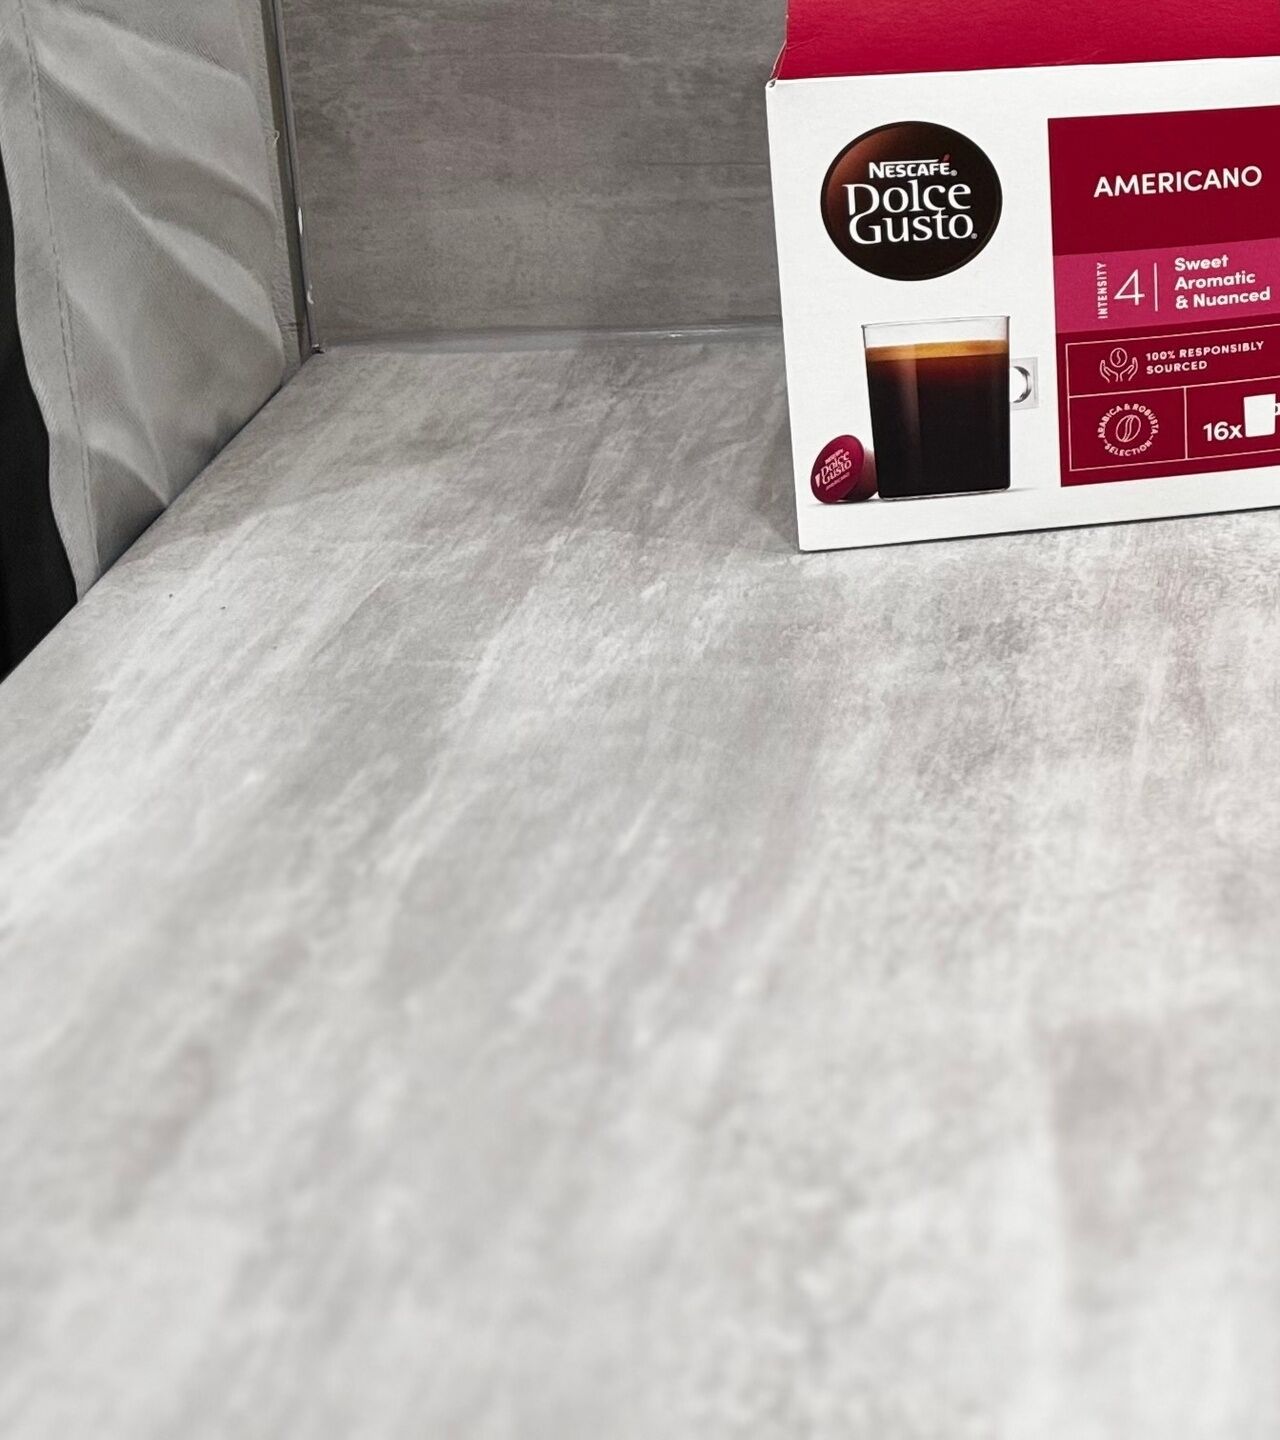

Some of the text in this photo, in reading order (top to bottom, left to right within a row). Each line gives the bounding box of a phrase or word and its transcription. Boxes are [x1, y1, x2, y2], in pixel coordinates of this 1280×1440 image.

[1093, 165, 1263, 198] AMERICANO
[842, 179, 972, 216] Dolce
[849, 211, 974, 244] Gusto
[1174, 255, 1229, 271] Sweet
[1096, 262, 1109, 319] INTENSITY
[1113, 268, 1145, 306] 4
[1174, 271, 1256, 291] Aromatic
[1175, 287, 1271, 309] & Nuanced
[1145, 340, 1264, 361] 100% RESPONSIBLY
[1146, 360, 1208, 375] SOURCED
[1097, 405, 1123, 439] ARABICA
[1132, 403, 1160, 435] ROBUSTA
[1203, 421, 1243, 442] 16x
[1104, 439, 1153, 457] SELECTION
